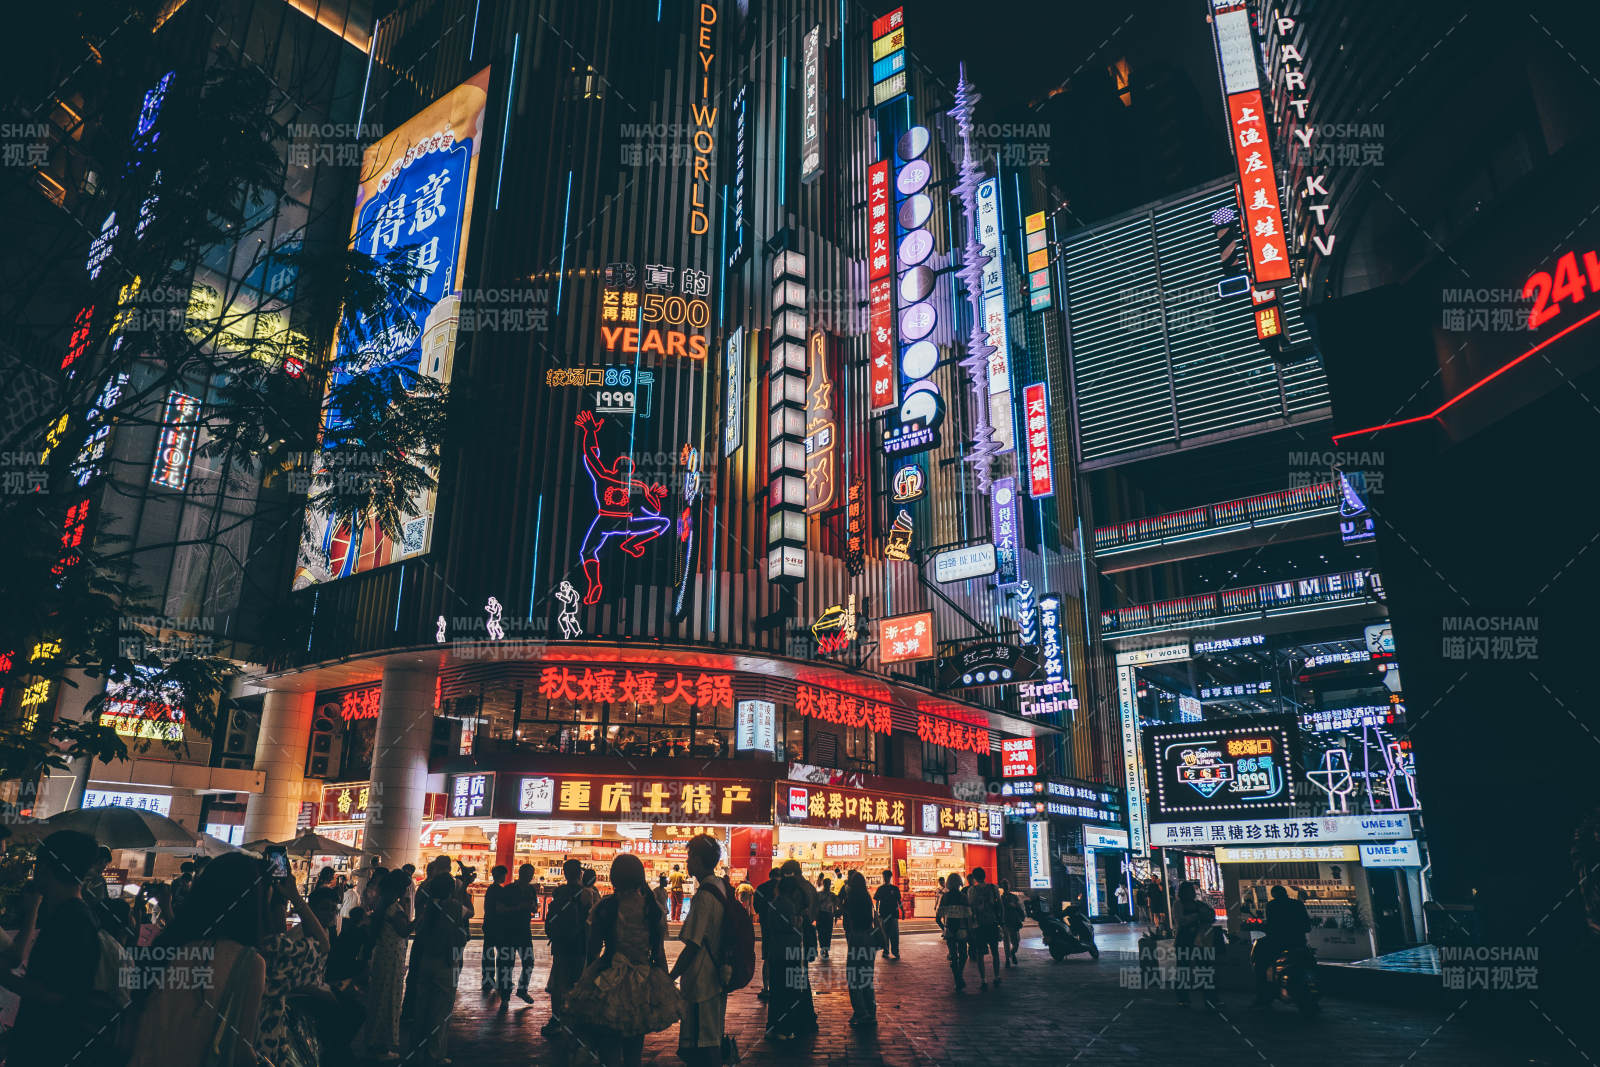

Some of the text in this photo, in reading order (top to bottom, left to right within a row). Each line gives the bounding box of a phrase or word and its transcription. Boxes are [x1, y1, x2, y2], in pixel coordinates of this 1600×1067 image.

[691, 3, 717, 235] DEYI WORLD
[1277, 17, 1336, 256] PARTY KTV
[642, 294, 710, 329] 500
[601, 326, 708, 361] YEARS
[597, 391, 635, 408] 1999
[884, 432, 934, 453] YUMMY!
[1158, 648, 1187, 657] WORLD
[1018, 678, 1072, 699] Street
[1020, 694, 1079, 716] Cuisine
[1123, 701, 1131, 728] WORLD
[1128, 763, 1136, 792] WORLD
[456, 776, 487, 797] 重庆
[1237, 772, 1268, 788] 1999
[453, 796, 484, 817] 特产
[559, 781, 752, 815] 重庆土特产
[808, 790, 905, 825] 磁器口陈麻花
[940, 807, 990, 832] 怪味胡豆
[1211, 822, 1319, 841] 黑糖珍珠奶茶
